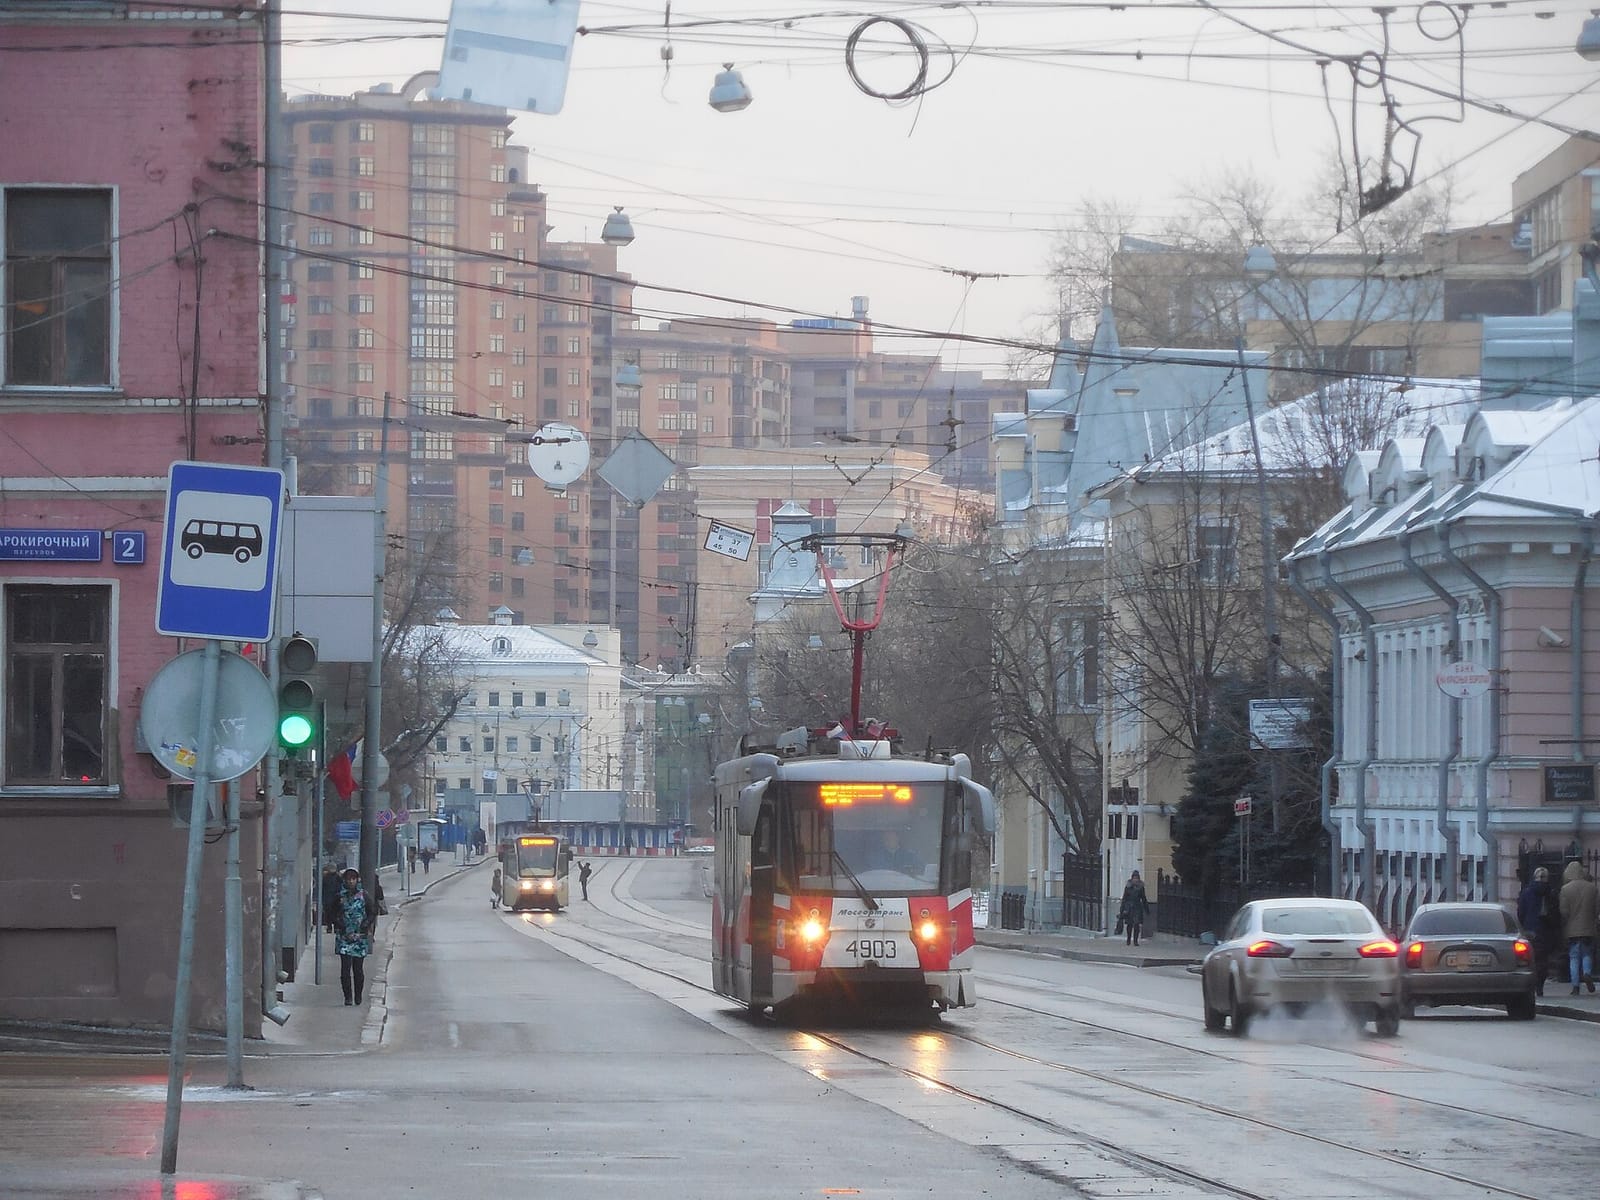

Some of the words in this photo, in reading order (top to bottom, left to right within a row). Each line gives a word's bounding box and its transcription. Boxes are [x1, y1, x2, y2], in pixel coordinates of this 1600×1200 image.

[122, 537, 135, 557] 2
[728, 547, 738, 555] 50
[838, 908, 904, 918] Мосгортранс
[845, 940, 897, 959] 4903
